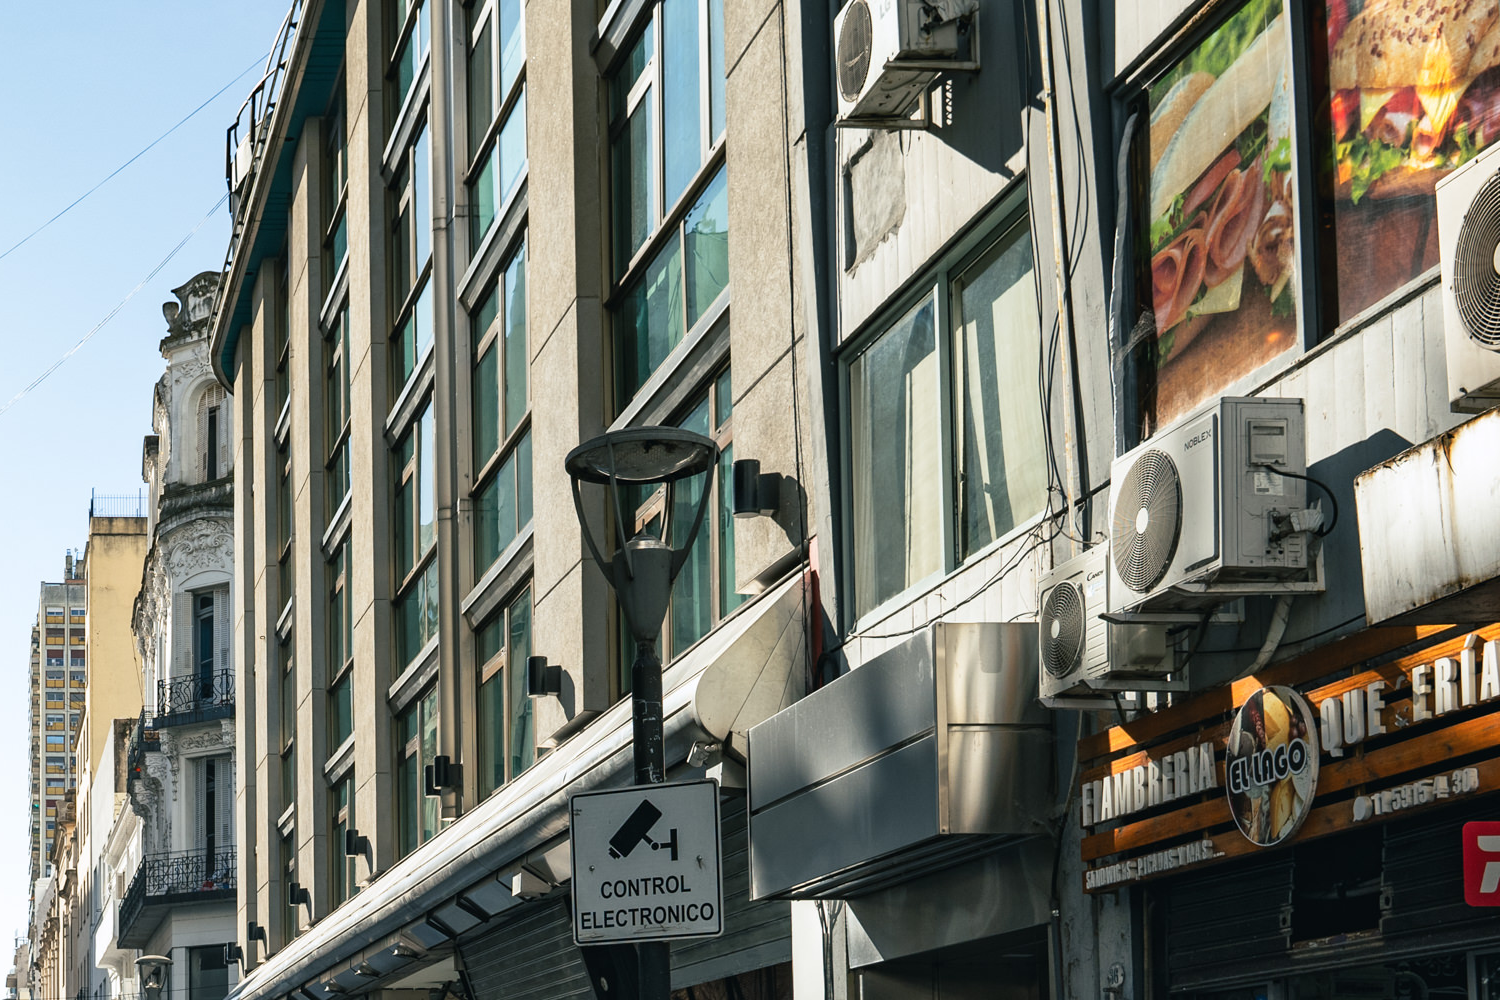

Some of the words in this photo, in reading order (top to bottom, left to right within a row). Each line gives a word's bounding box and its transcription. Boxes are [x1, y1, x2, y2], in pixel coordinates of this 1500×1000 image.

[879, 1, 891, 19] LG
[1184, 428, 1212, 451] NOBLEX
[1231, 757, 1249, 793] EL
[1253, 738, 1307, 786] LAGO
[1082, 742, 1218, 827] FIAMBRERIA
[601, 875, 691, 899] CONTROL
[581, 902, 714, 930] ELECTRONICO
